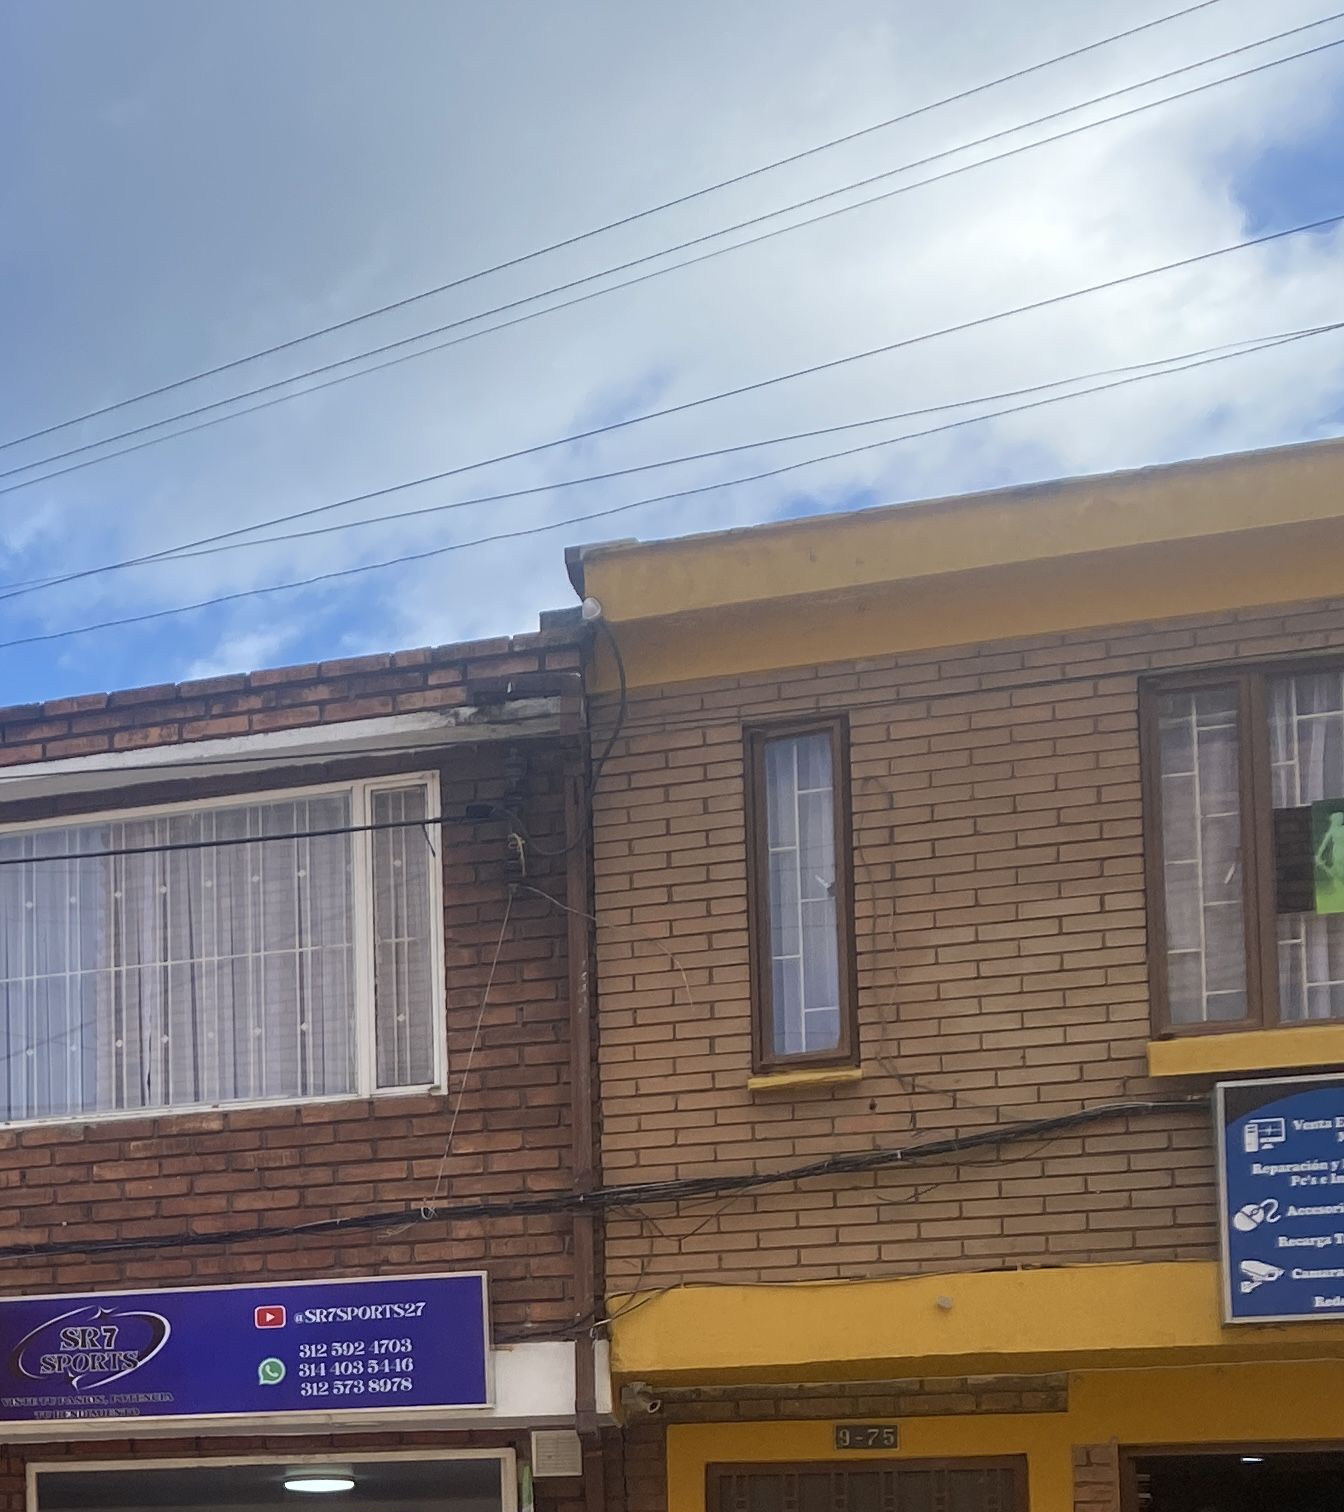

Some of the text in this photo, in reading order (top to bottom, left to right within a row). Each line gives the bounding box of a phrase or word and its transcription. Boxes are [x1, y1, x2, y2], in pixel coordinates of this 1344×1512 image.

[294, 1302, 426, 1324] @SR7SPORTS27
[60, 1325, 119, 1351] SR7
[299, 1338, 413, 1358] 312 592 4703
[40, 1351, 139, 1374] SPORTS
[298, 1358, 414, 1377] 314 403 5446
[300, 1377, 413, 1397] 312 573 8978
[839, 1428, 895, 1446] 9-75
